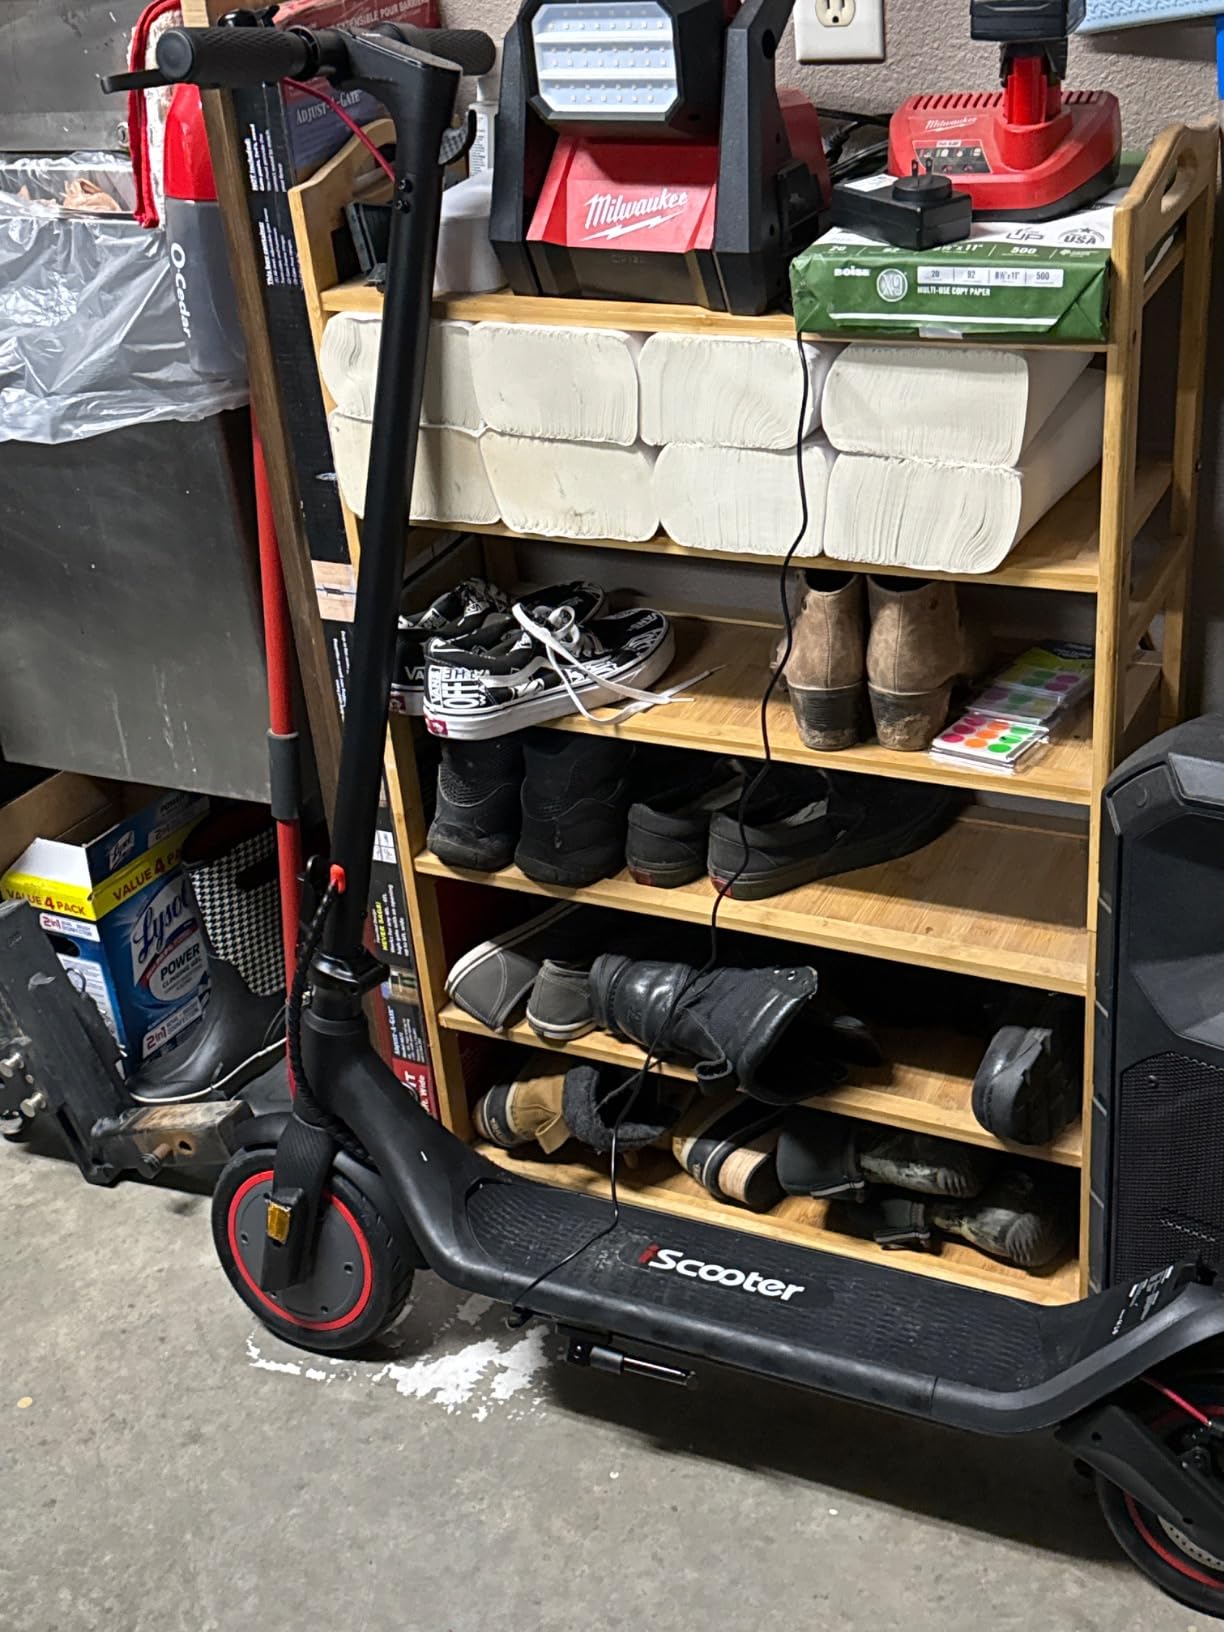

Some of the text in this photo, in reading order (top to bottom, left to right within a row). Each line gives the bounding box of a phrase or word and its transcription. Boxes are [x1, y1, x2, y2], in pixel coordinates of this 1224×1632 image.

[925, 117, 977, 130] Milwaukee
[584, 188, 688, 230] Milwaukee
[1063, 234, 1097, 245] USA
[1036, 272, 1050, 281] 500
[917, 285, 991, 297] MULTI-USE COPY PAPER
[404, 666, 425, 680] VA
[113, 871, 153, 902] VALUE
[154, 858, 166, 876] 4
[6, 889, 86, 916] VAUE 4 PACK
[133, 877, 190, 964] Lysol
[160, 943, 200, 981] POWER
[146, 1026, 168, 1050] 2in1
[638, 1243, 805, 1301] iScooter
